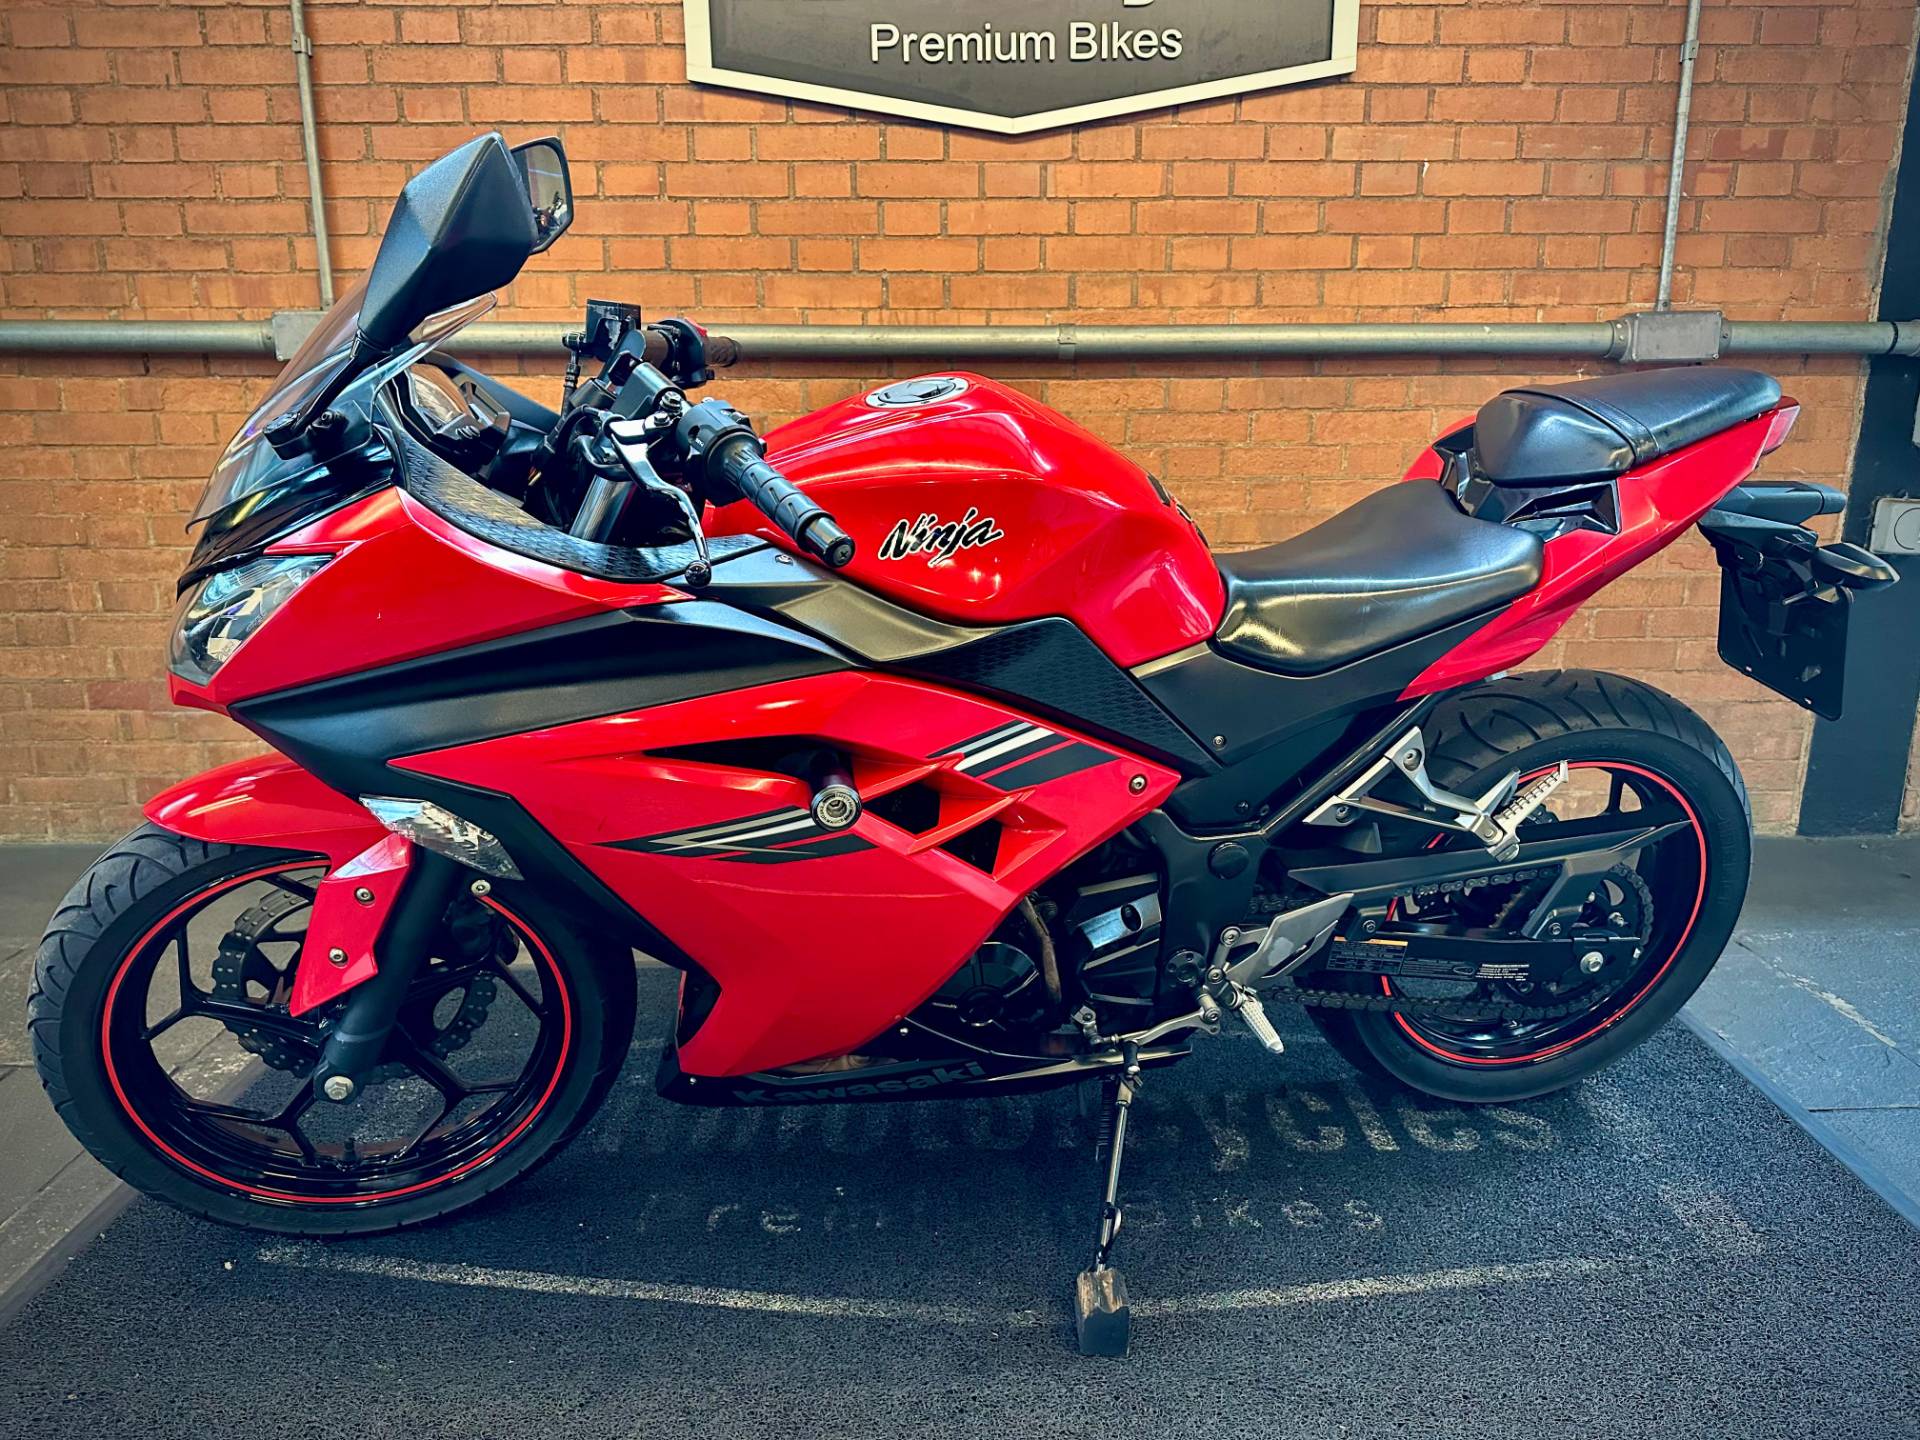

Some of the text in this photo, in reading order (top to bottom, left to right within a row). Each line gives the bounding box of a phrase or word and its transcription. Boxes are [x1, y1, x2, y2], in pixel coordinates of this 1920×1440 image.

[870, 22, 1057, 62] Premium
[877, 507, 1005, 568] Ninja
[732, 1060, 987, 1103] Kawasaki
